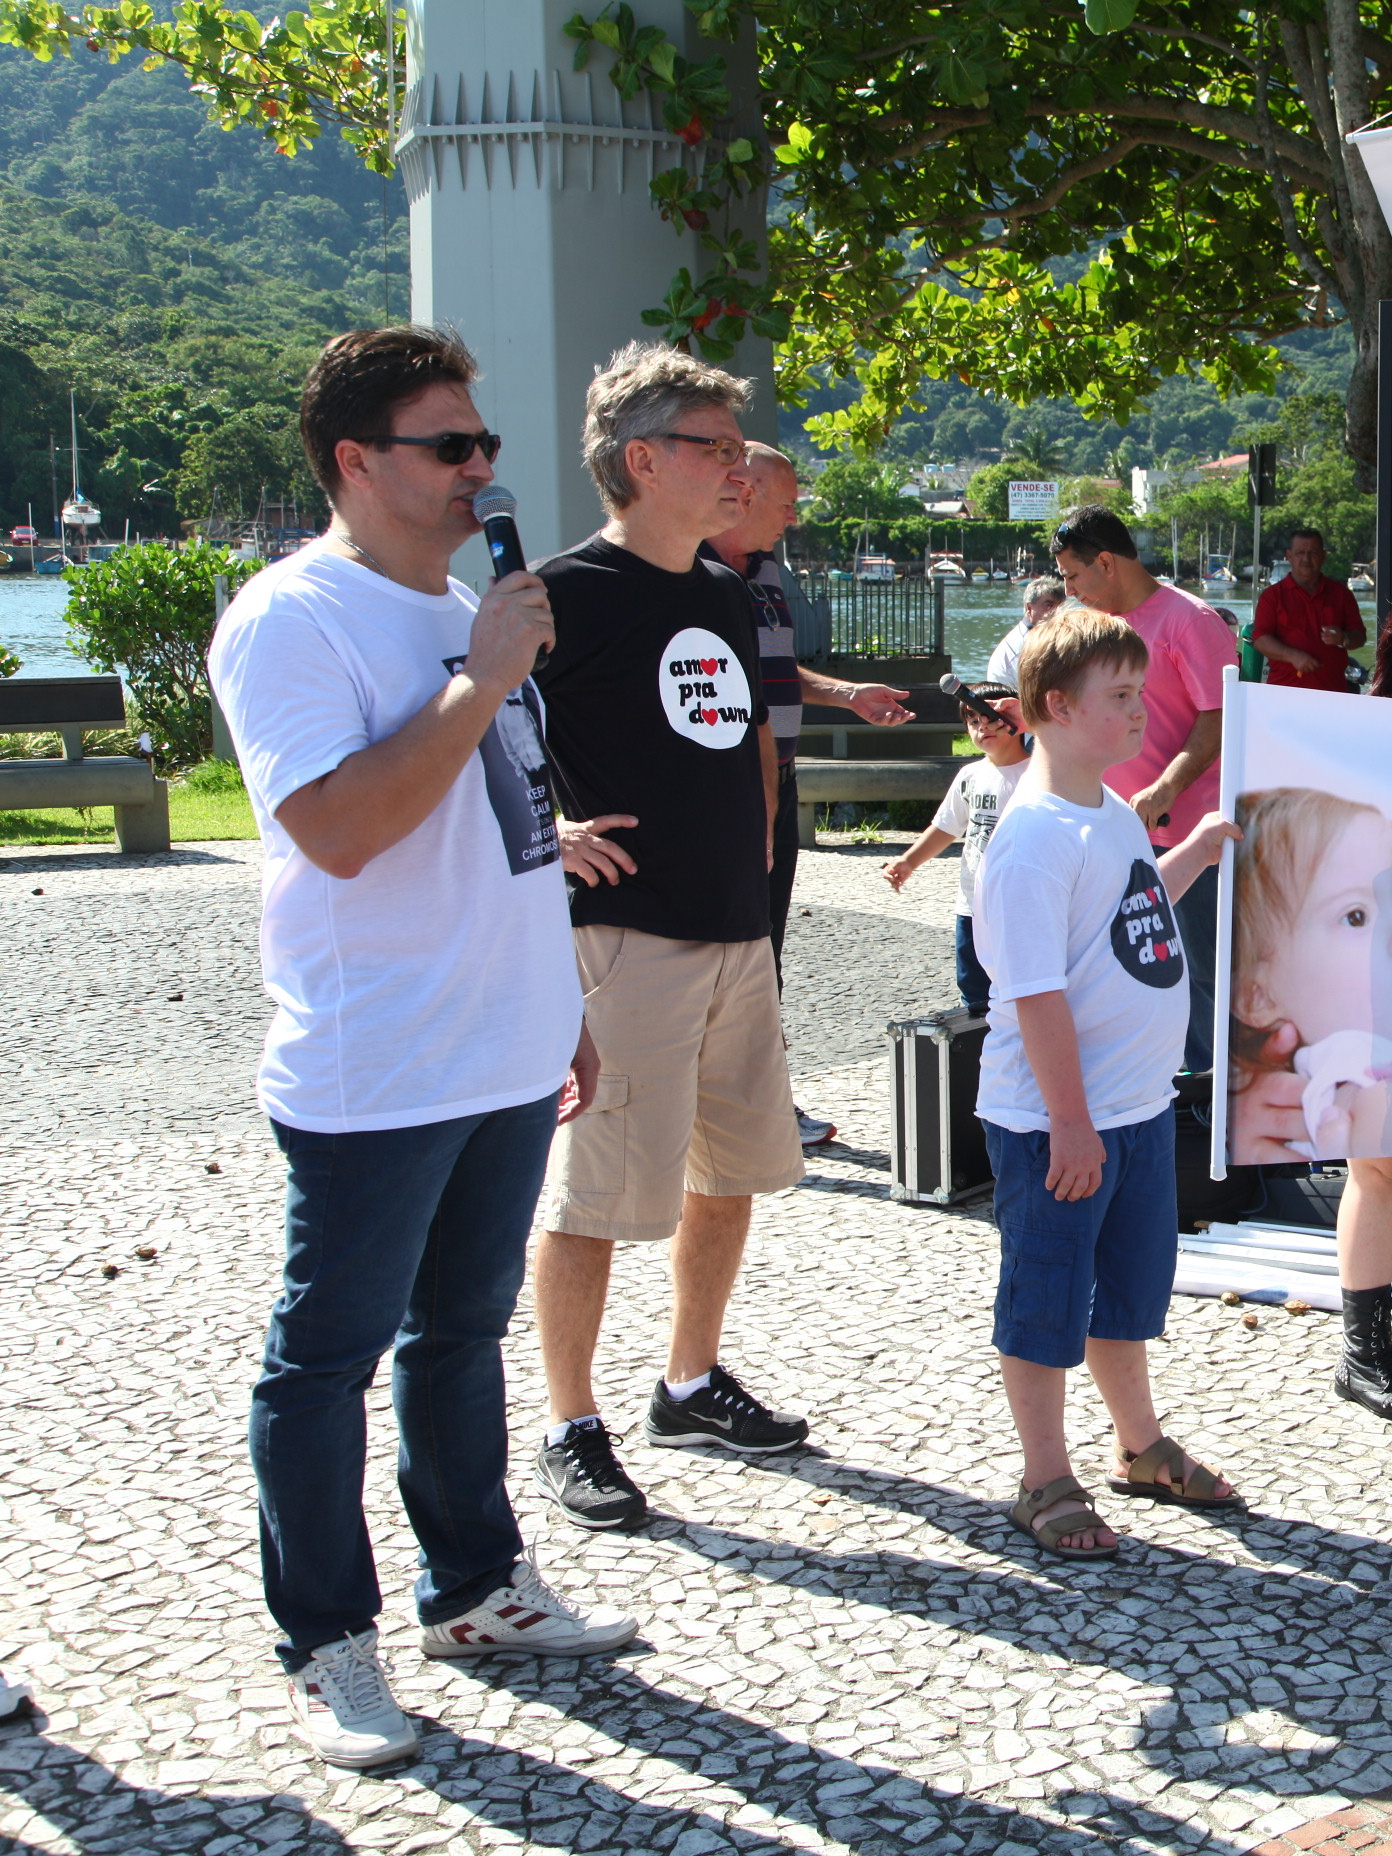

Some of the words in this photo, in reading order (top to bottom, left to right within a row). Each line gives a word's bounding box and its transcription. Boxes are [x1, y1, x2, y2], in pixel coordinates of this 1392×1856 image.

[1010, 483, 1055, 492] VENDE-SE
[679, 680, 718, 706] pra
[526, 785, 546, 801] KEEP
[531, 801, 551, 817] CALM
[531, 830, 543, 843] AN
[542, 825, 557, 839] EXTR
[522, 839, 558, 861] CHROMOS
[1126, 913, 1164, 945] pra
